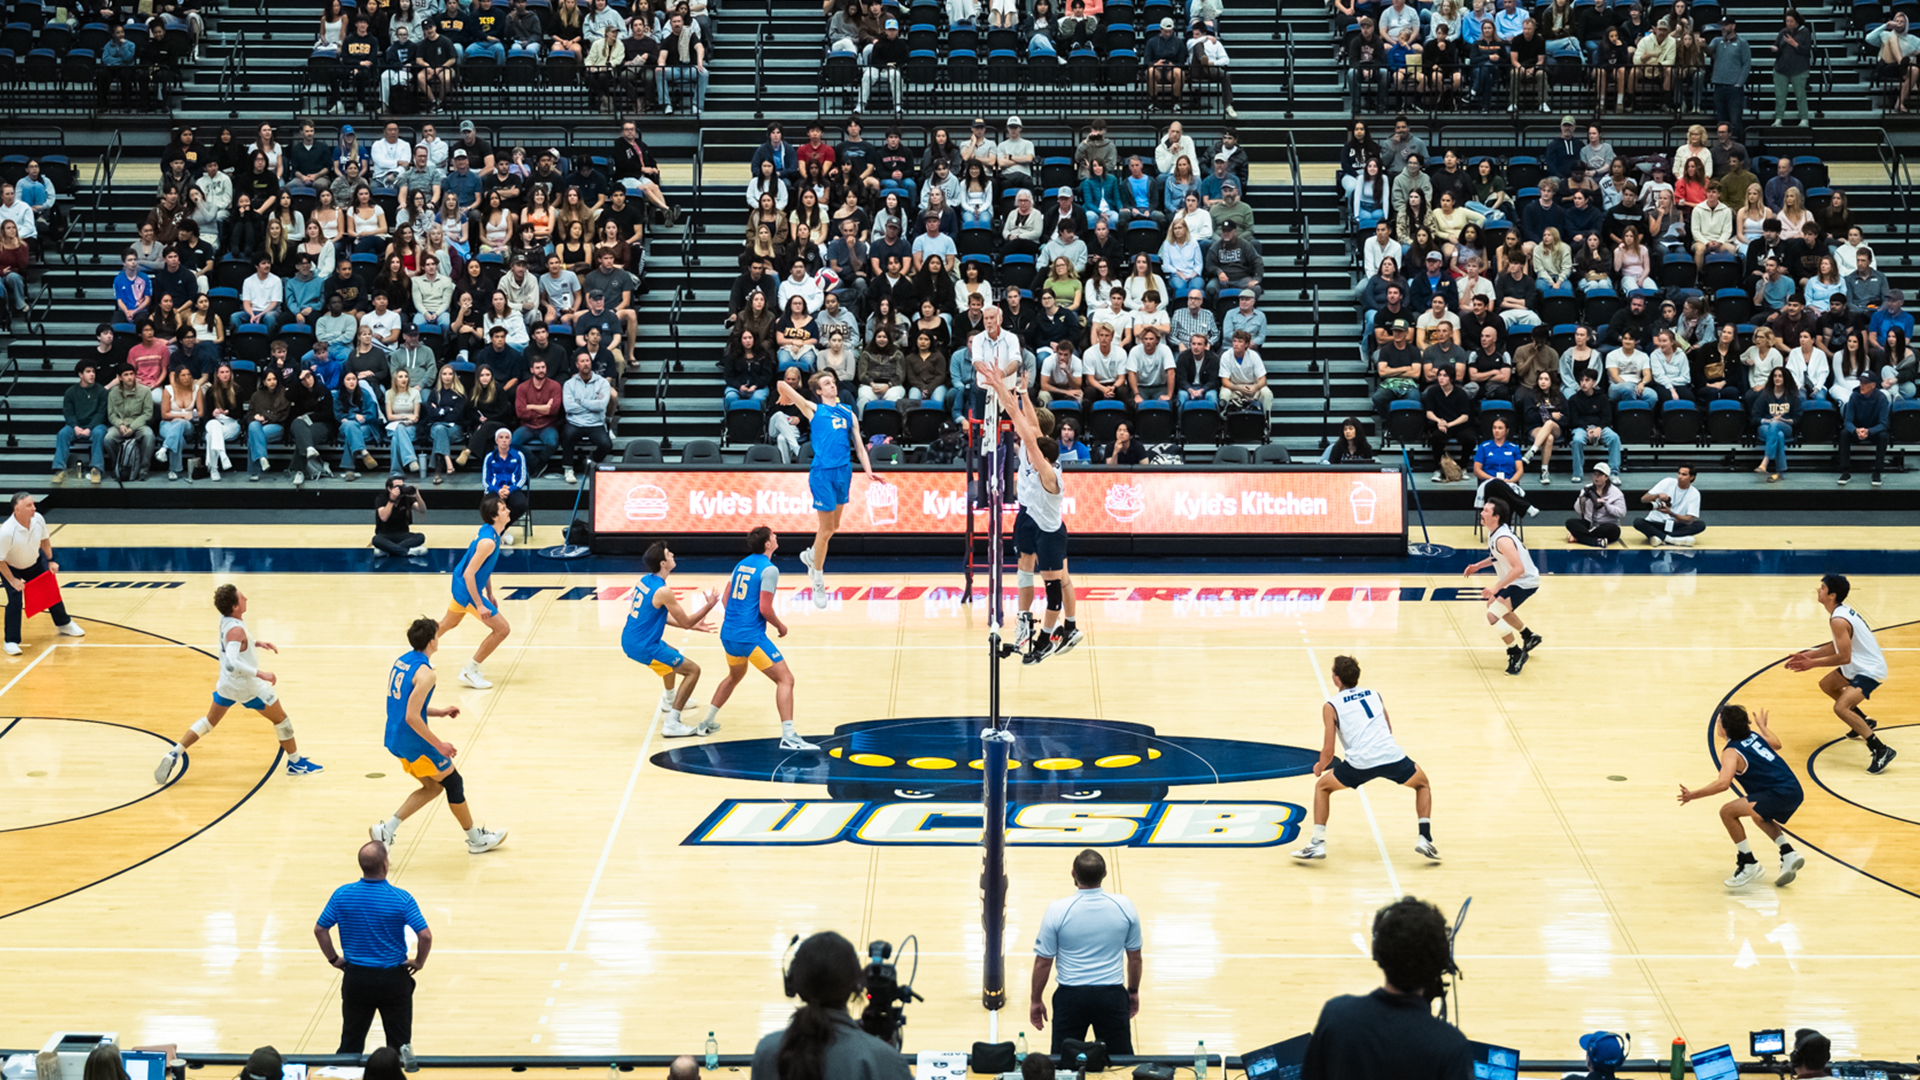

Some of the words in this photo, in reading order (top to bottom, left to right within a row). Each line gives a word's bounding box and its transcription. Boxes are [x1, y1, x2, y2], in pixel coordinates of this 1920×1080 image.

[689, 490, 752, 519] Kyle's
[1174, 491, 1237, 520] Kyle's
[1241, 491, 1327, 515] Kitchen
[732, 573, 751, 600] 15
[1343, 690, 1371, 703] UCSB
[1360, 698, 1374, 719] 1
[680, 798, 1308, 848] UCSB
